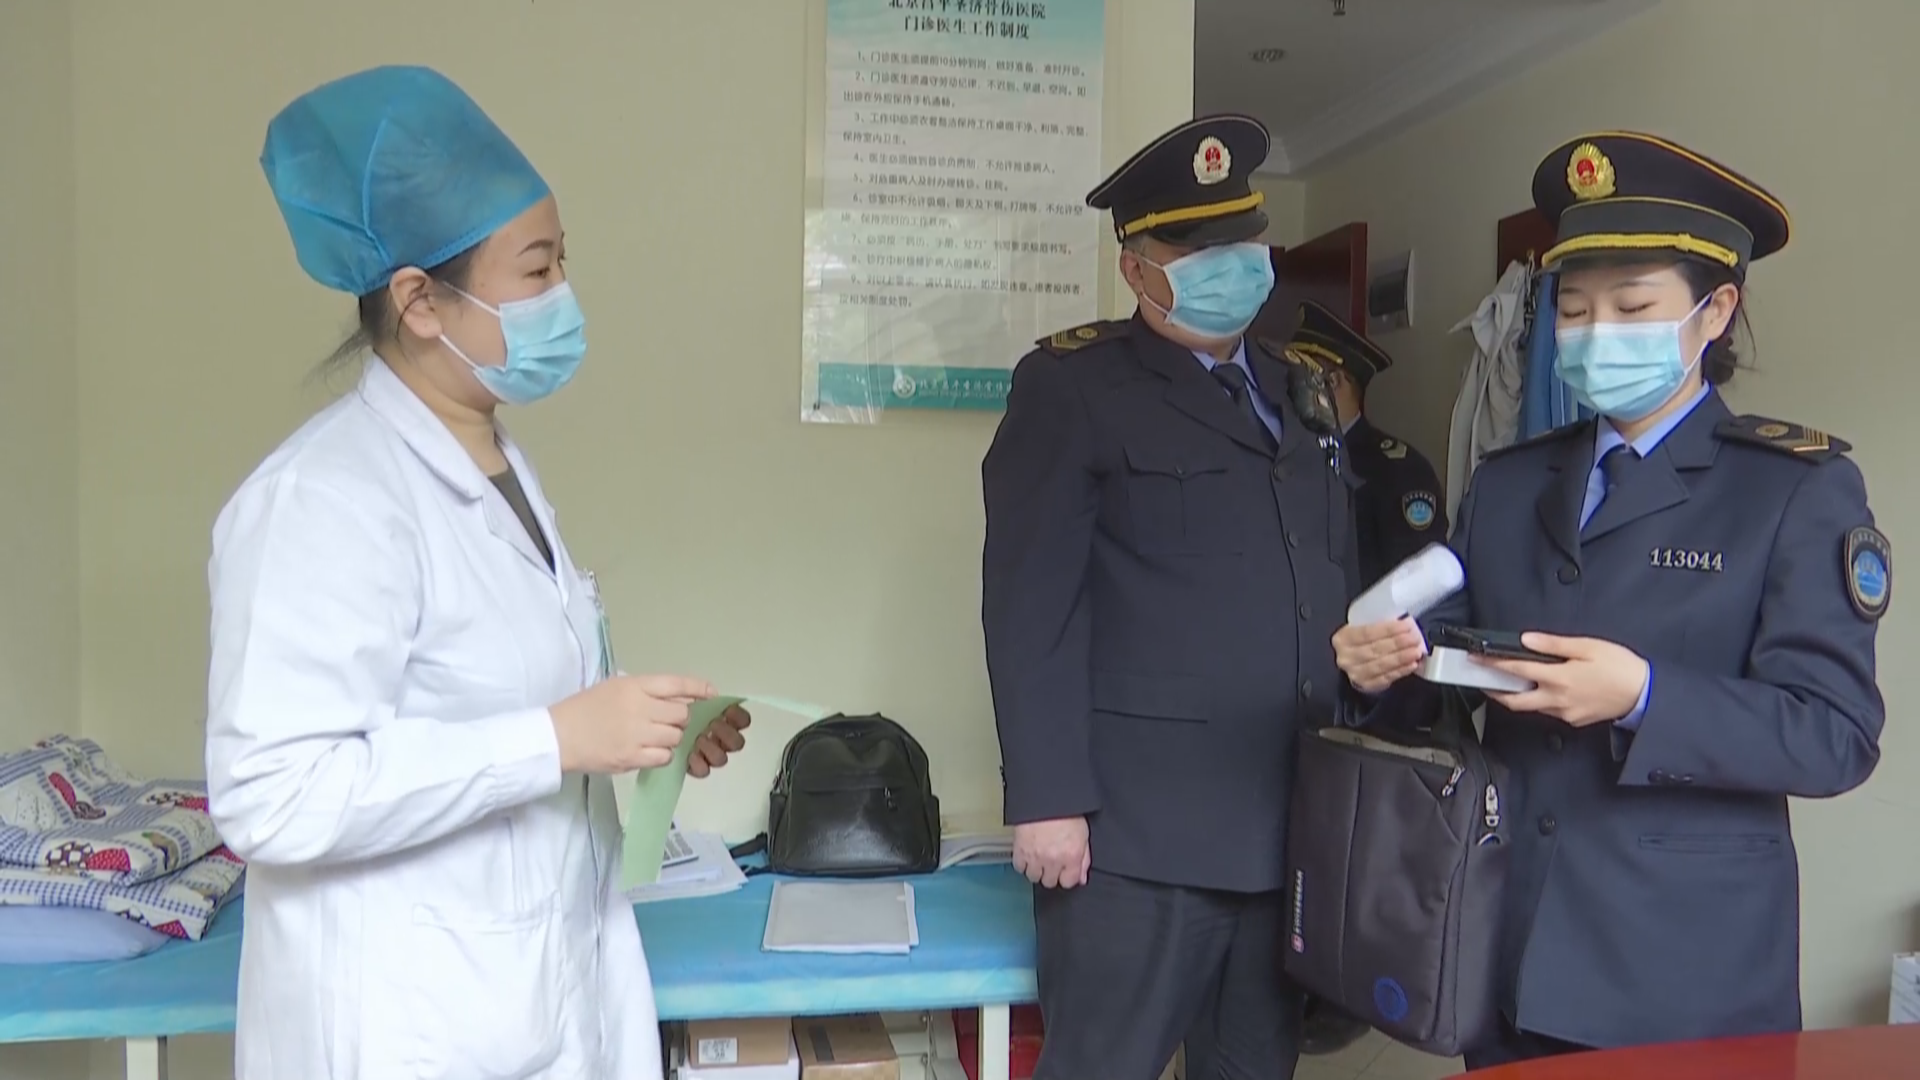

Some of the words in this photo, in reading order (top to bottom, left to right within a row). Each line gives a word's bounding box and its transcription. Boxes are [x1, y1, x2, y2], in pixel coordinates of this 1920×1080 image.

[904, 16, 1029, 39] 门诊医生工作制度
[1650, 547, 1723, 572] 113044
